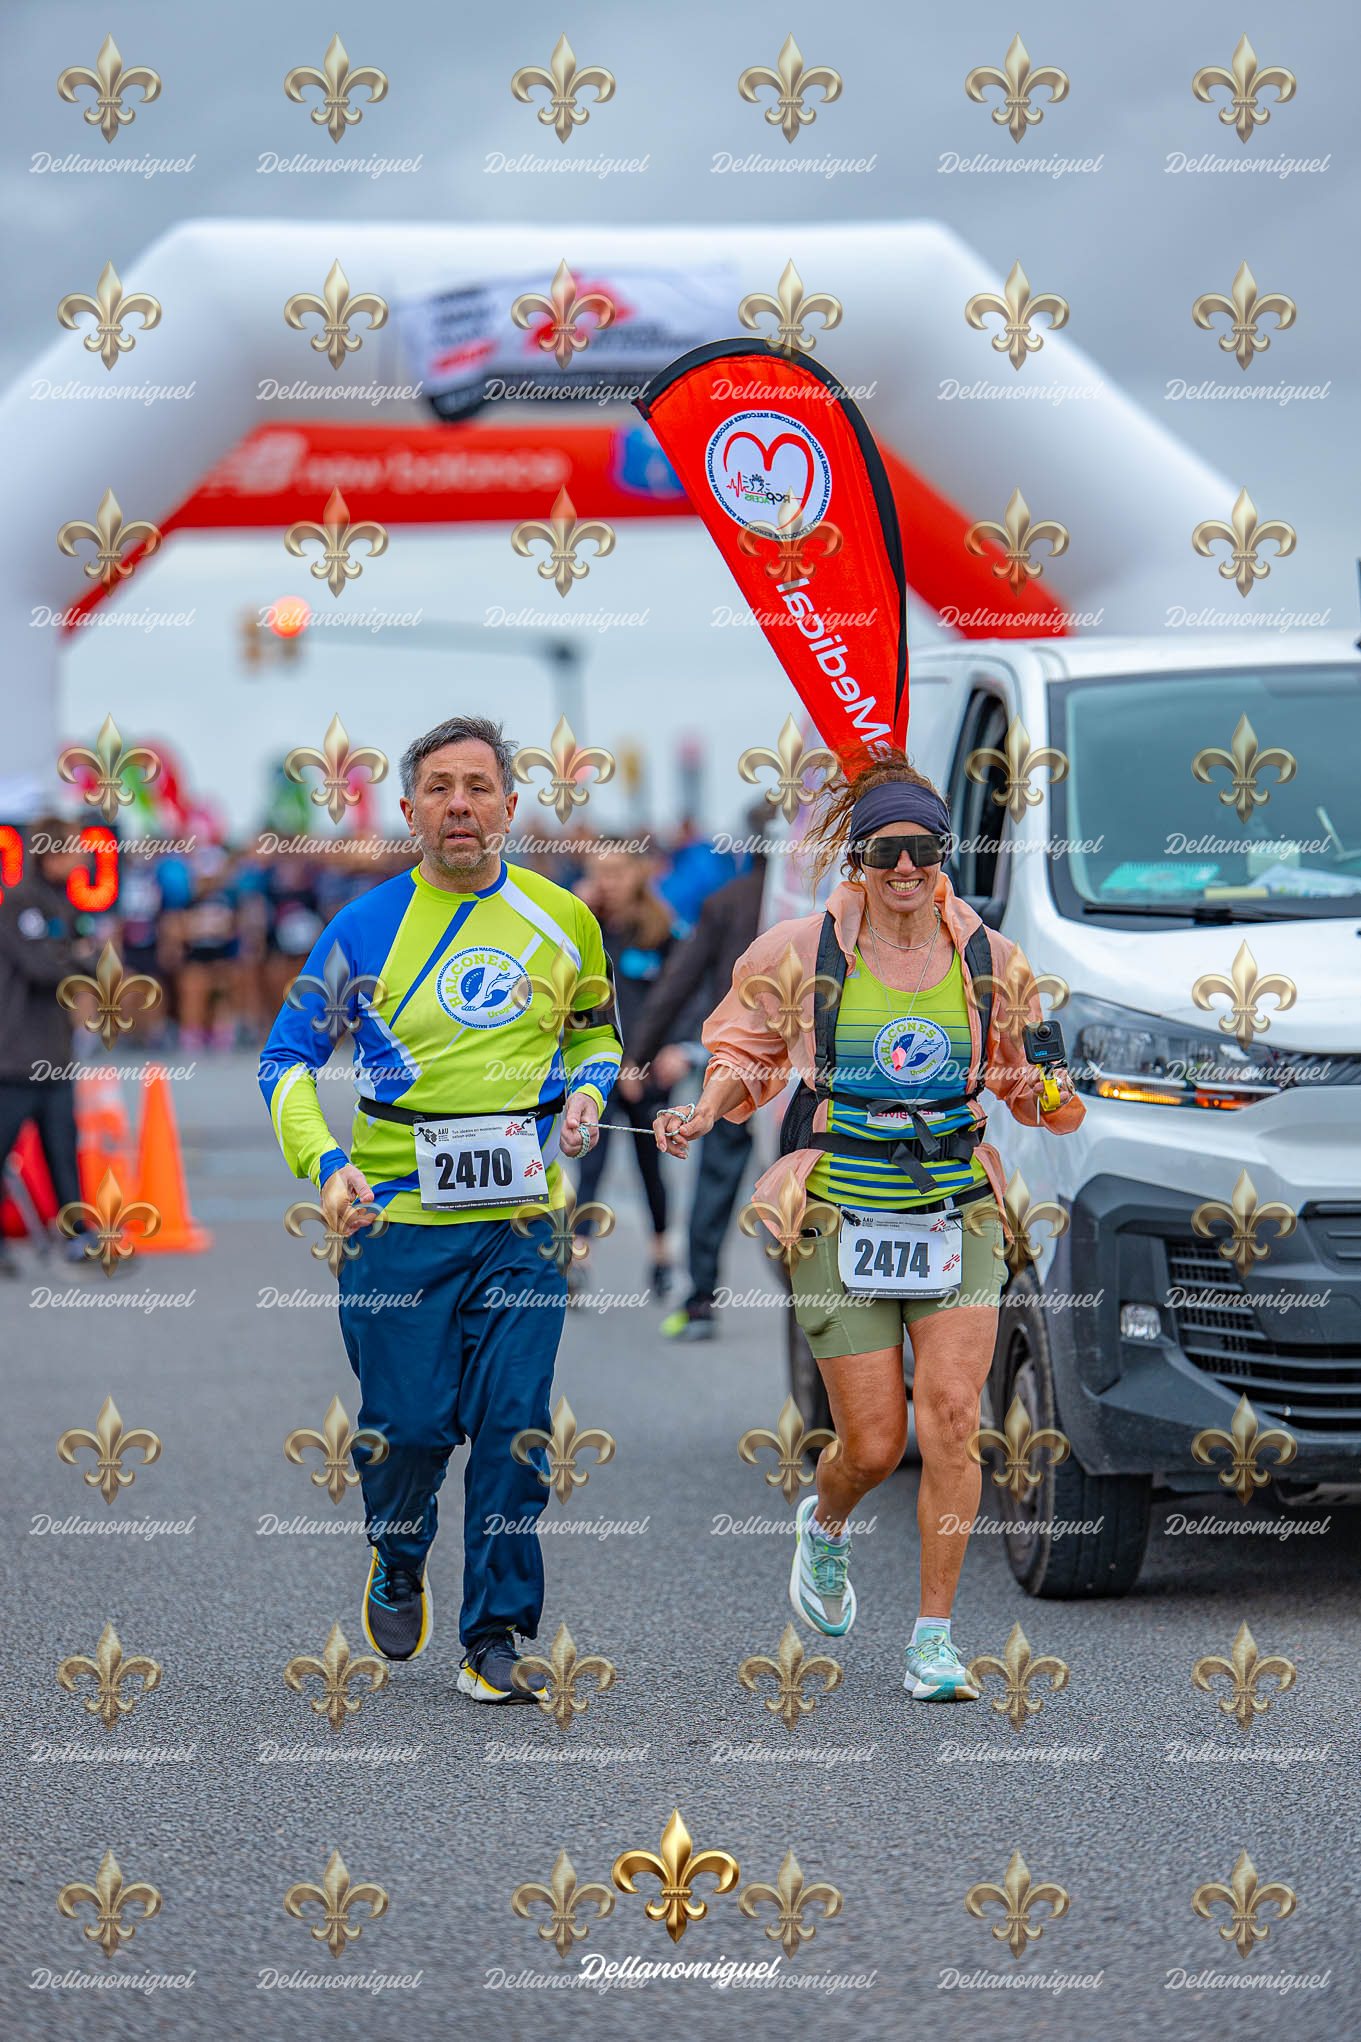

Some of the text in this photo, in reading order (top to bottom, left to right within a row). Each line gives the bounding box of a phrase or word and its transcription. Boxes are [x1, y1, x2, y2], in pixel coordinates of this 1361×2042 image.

[445, 953, 511, 1008] HALCONES
[435, 1148, 512, 1190] 2470
[855, 1239, 930, 1278] 2474
